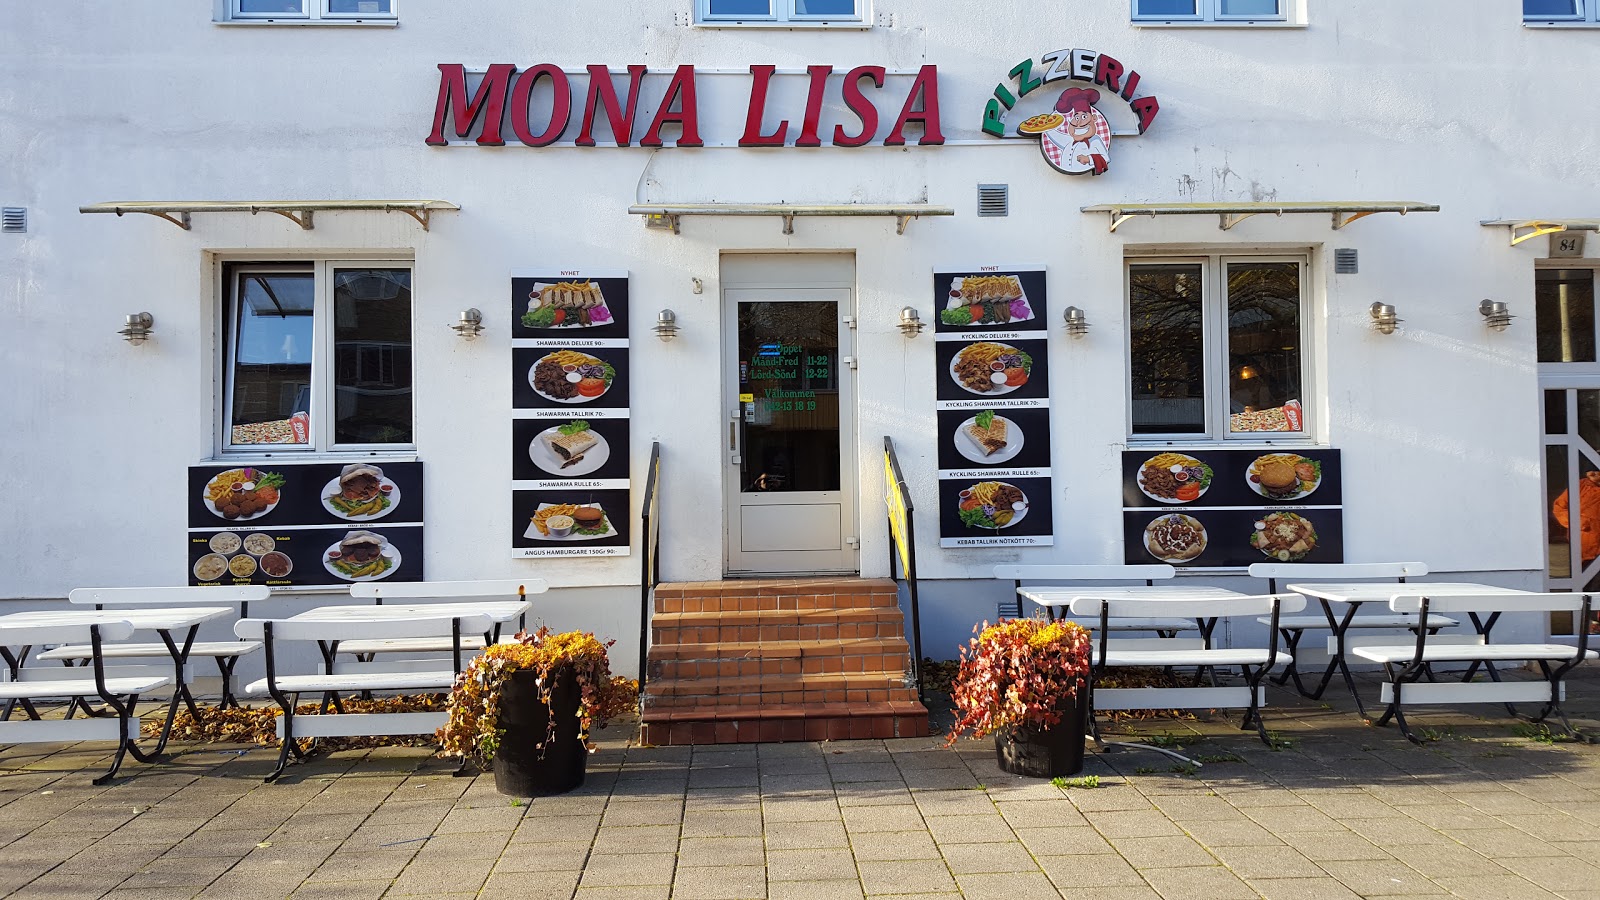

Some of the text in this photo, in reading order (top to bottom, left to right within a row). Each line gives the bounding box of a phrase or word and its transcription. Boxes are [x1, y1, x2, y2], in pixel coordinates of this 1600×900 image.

[981, 48, 1160, 138] PIZZERIA
[425, 63, 945, 147] MONA LISA
[1560, 239, 1576, 251] 84
[776, 342, 802, 355] Öppet
[807, 356, 828, 365] 11-22
[751, 369, 796, 379] Lörd-Sönd
[805, 369, 828, 379] 12-22
[764, 389, 815, 398] Välkommen
[795, 401, 804, 411] 18
[807, 401, 816, 411] 19
